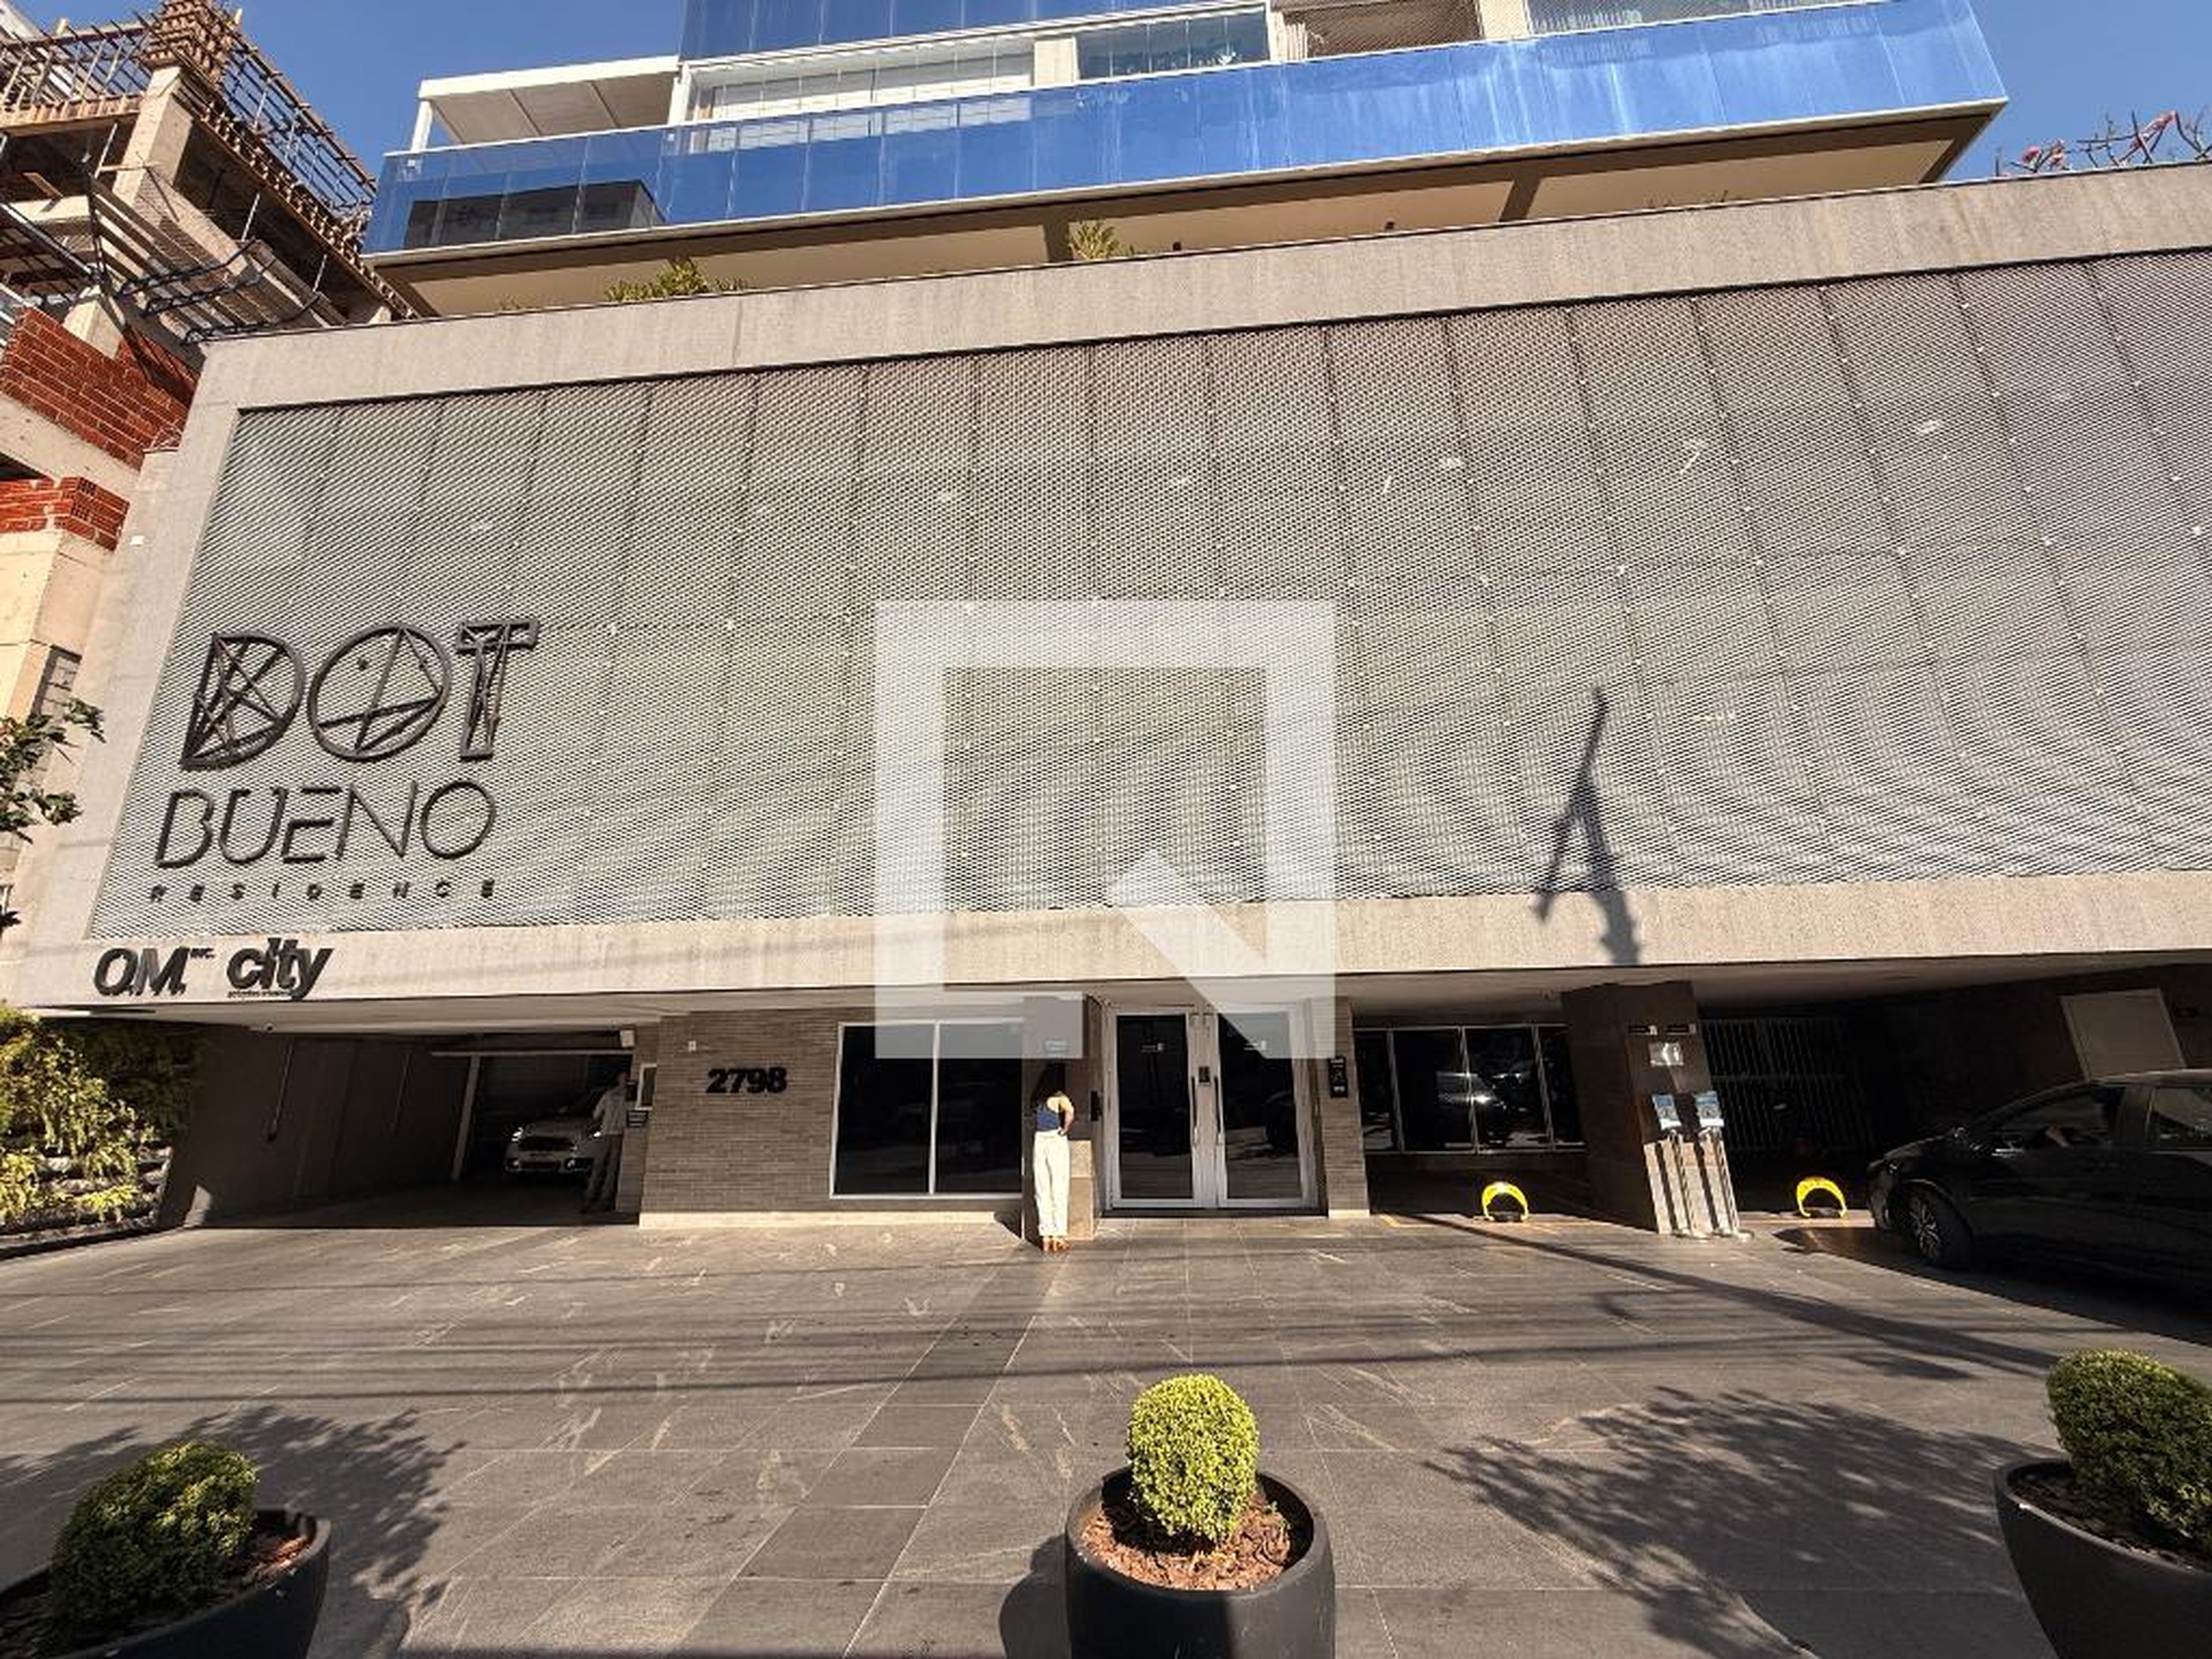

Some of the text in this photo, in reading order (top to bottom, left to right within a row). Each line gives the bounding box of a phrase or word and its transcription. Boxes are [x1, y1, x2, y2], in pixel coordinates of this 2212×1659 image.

[179, 616, 540, 772] DOT
[154, 778, 497, 868] BUENO
[149, 879, 497, 903] RESIDENCE
[226, 937, 334, 1001] city
[706, 1067, 787, 1093] 2798
